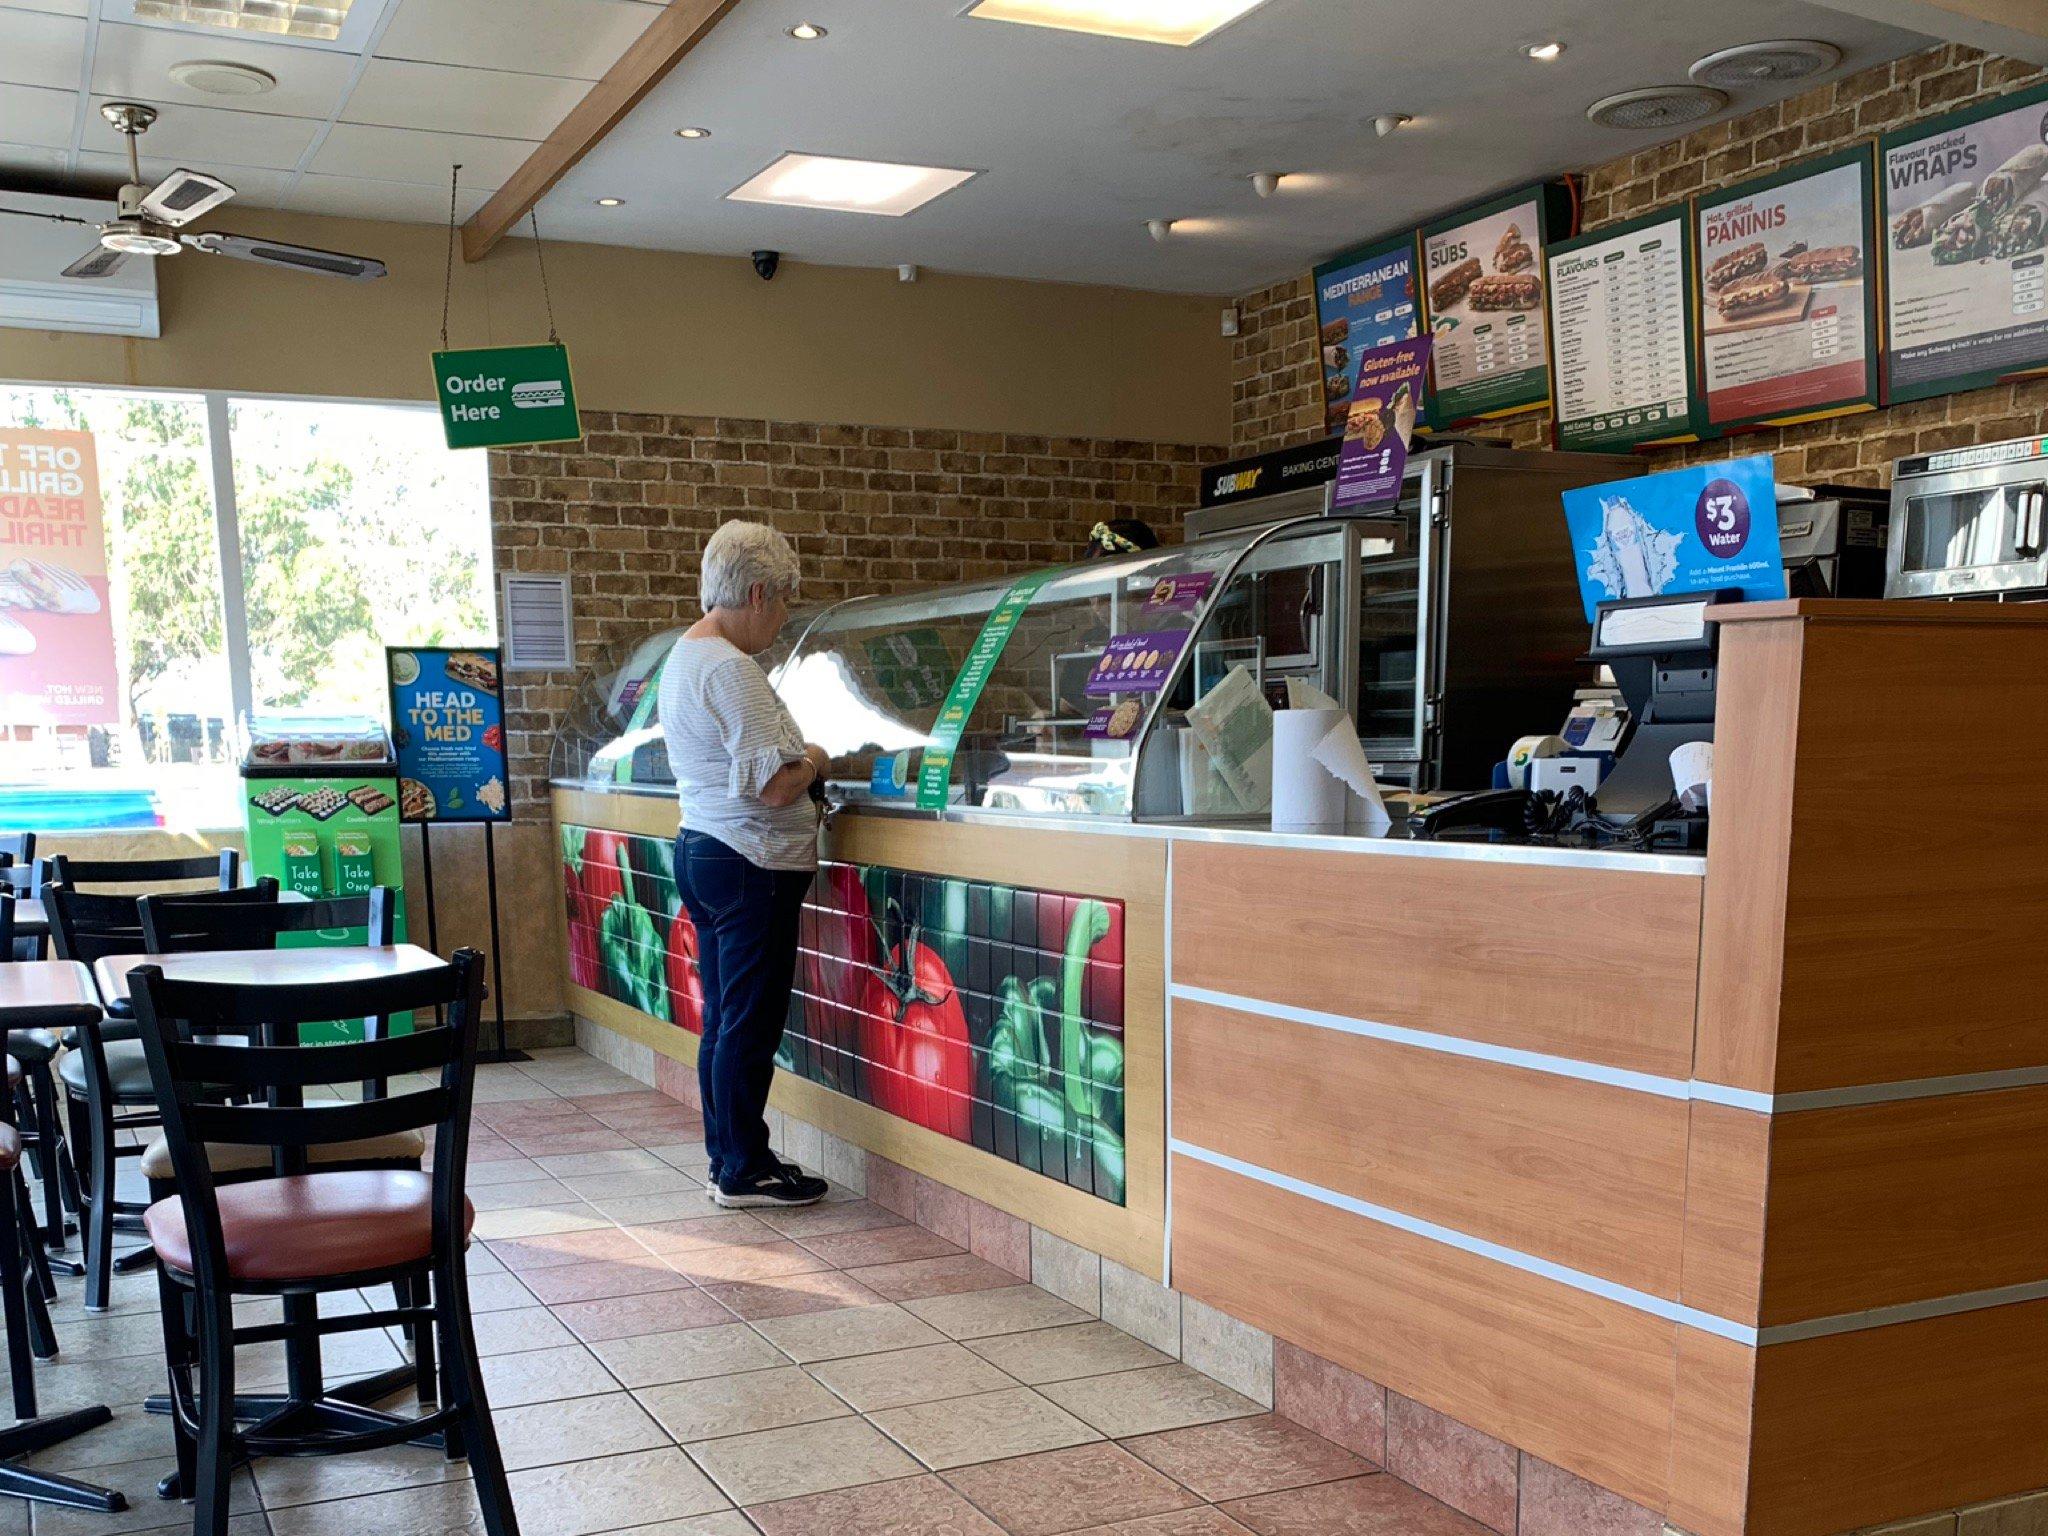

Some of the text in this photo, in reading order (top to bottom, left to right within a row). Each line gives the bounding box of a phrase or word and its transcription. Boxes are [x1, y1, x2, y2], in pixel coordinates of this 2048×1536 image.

[1889, 132, 1966, 166] Flavour packed
[1889, 143, 1978, 190] WRAPS
[1726, 200, 1753, 221] grilled
[1706, 203, 1787, 248] PANINIS
[1430, 240, 1468, 269] SUBS
[1557, 256, 1600, 278] FLAVOURS
[1323, 259, 1408, 302] MEDITERRANEAN
[1363, 351, 1416, 373] Gluten-free
[446, 373, 506, 394] Order
[1359, 363, 1421, 389] now available
[451, 402, 501, 422] Here
[1213, 467, 1263, 497] SUBWAY
[1282, 460, 1315, 477] BAKING
[1708, 533, 1741, 547] Water
[415, 691, 476, 708] HEAD
[407, 708, 485, 726] TO THE
[424, 725, 472, 742] MED
[291, 865, 319, 880] Take
[343, 864, 370, 879] Take
